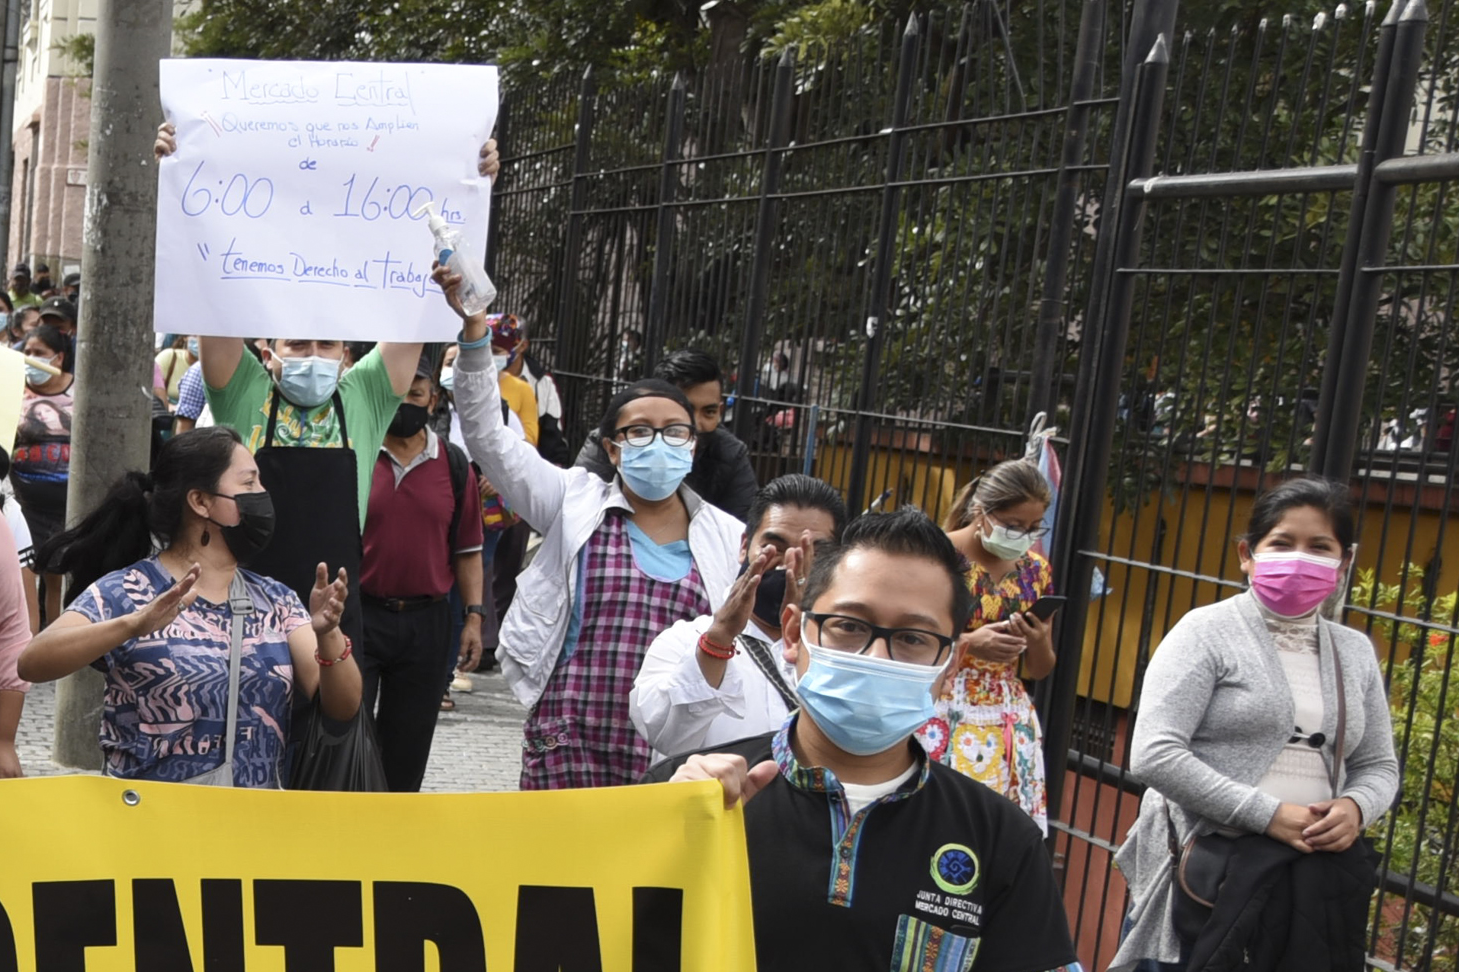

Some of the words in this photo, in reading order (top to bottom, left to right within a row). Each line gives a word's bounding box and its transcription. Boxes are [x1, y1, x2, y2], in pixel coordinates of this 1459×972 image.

[299, 157, 317, 171] de
[182, 160, 274, 218] 6:00
[334, 173, 433, 221] 16:00
[914, 899, 950, 917] MERCADO
[951, 909, 981, 926] CENTRAL
[916, 889, 942, 904] JUNTA
[944, 896, 983, 915] DIRECTIVA
